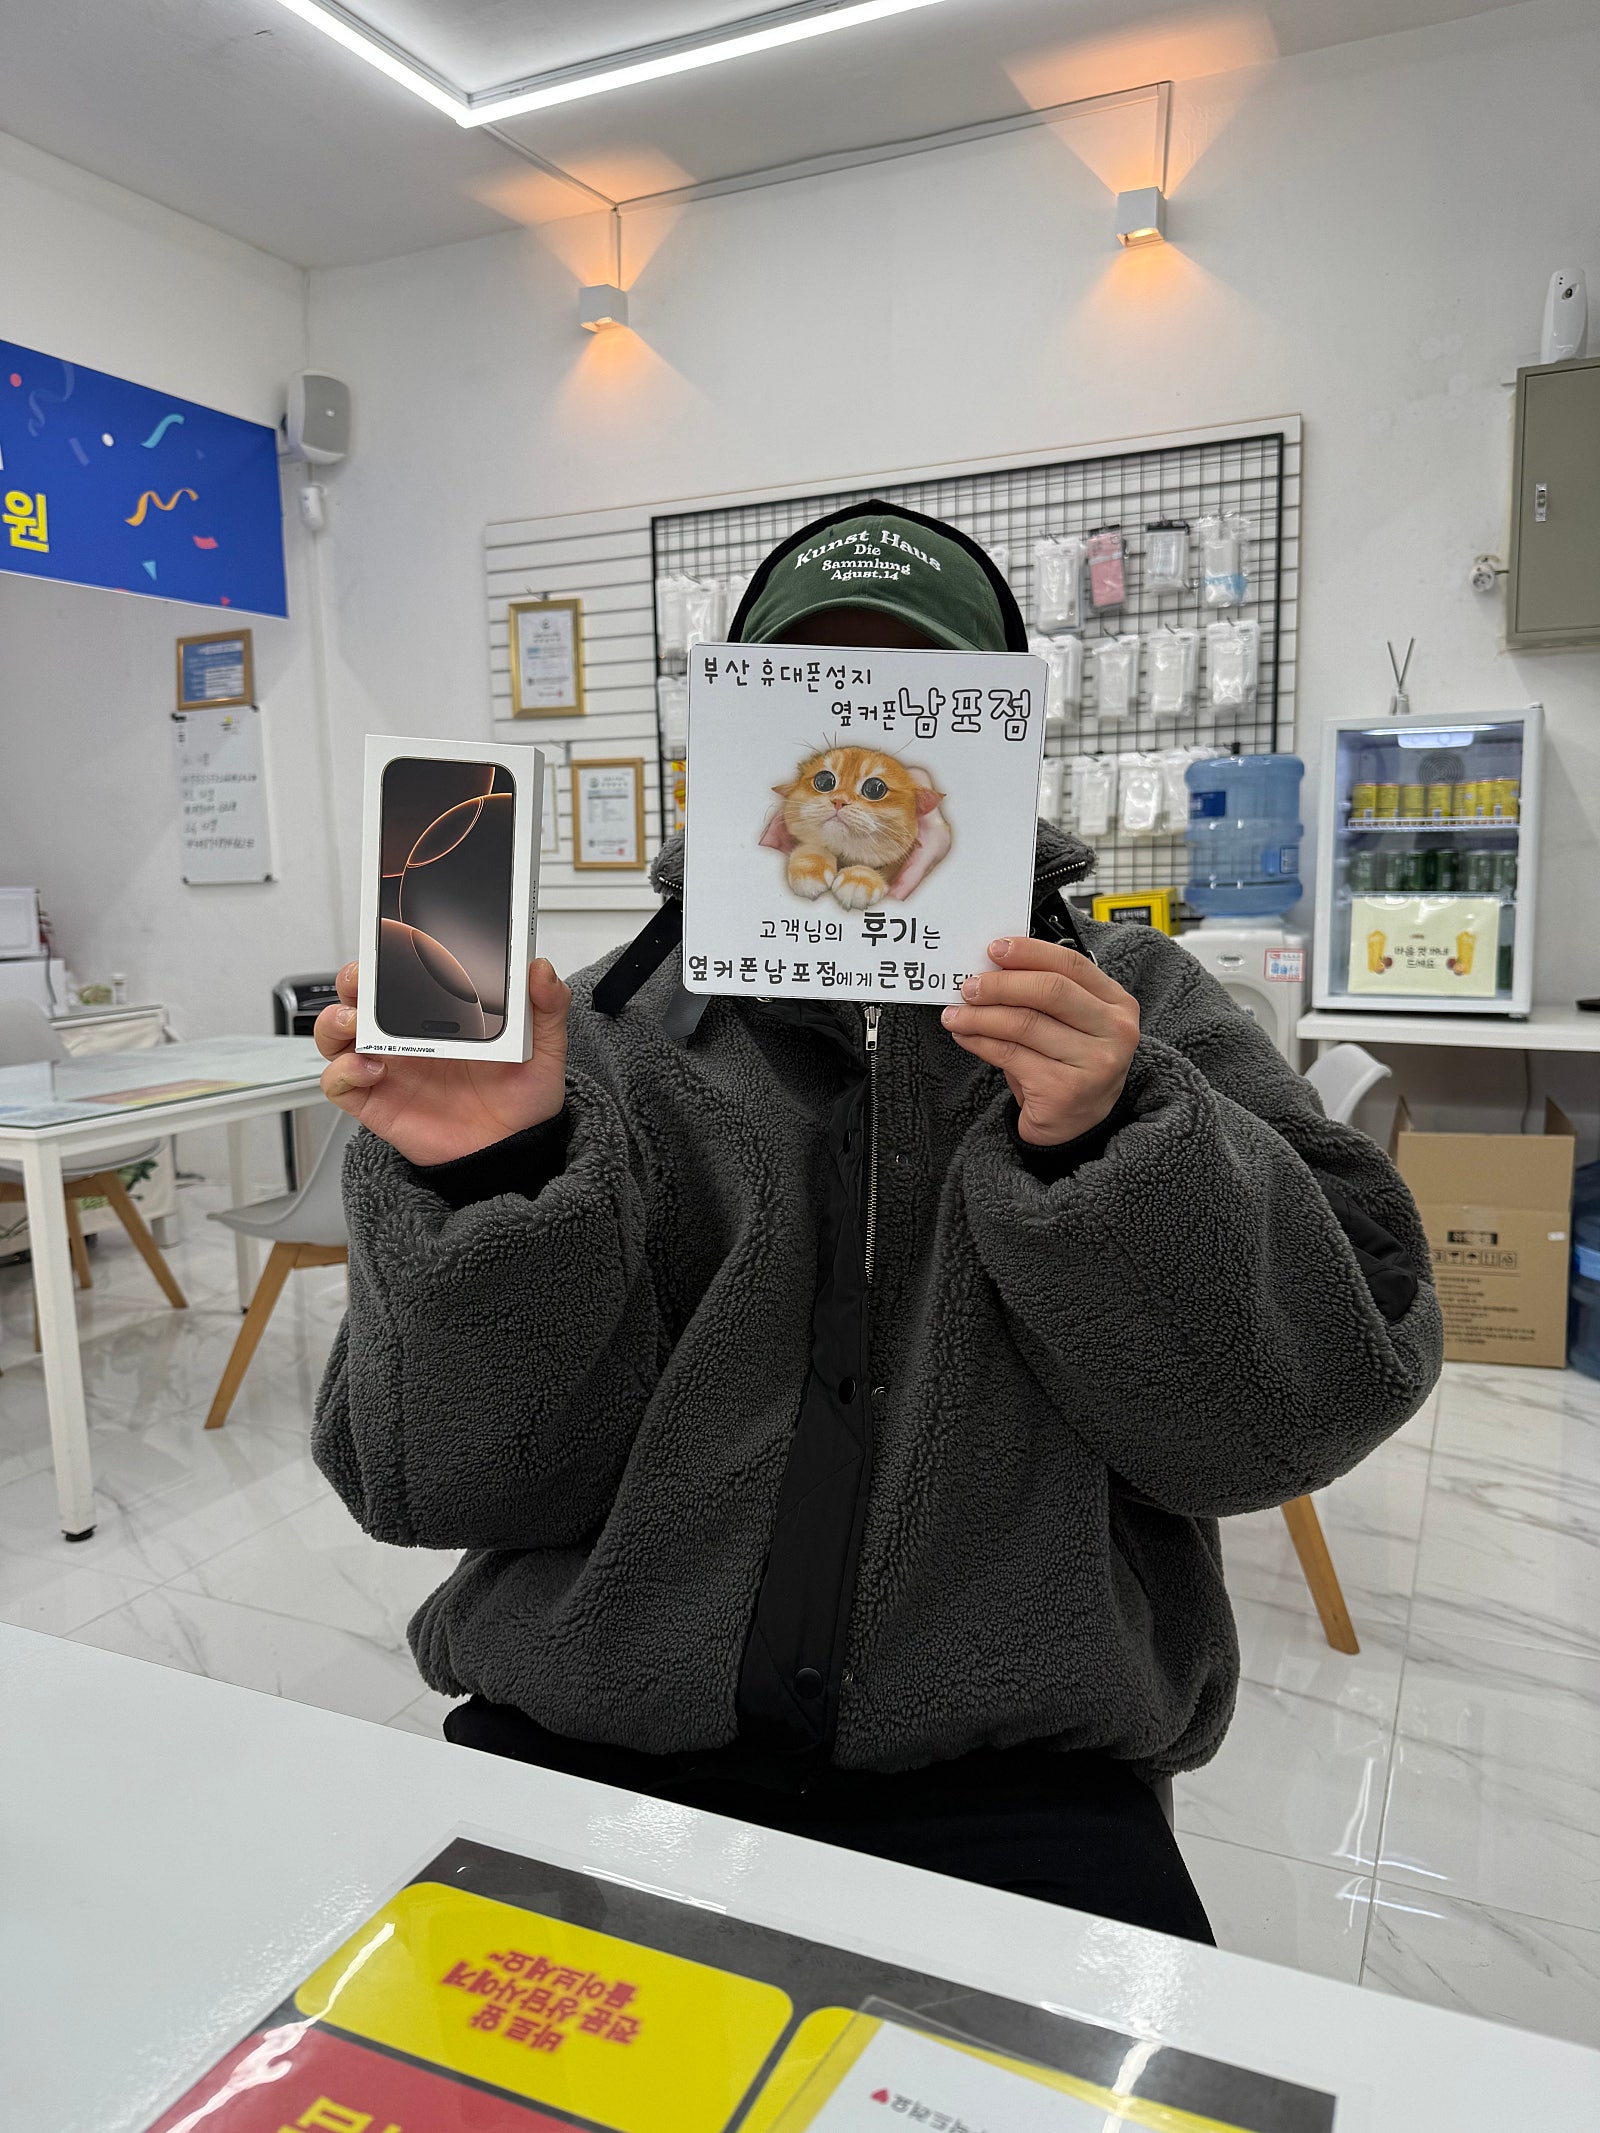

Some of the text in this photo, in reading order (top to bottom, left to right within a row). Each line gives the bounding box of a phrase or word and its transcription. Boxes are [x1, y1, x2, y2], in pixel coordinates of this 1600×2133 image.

[2, 489, 50, 553] 원
[794, 529, 942, 572] Kunst Haus
[821, 557, 911, 576] Sammlung
[853, 543, 882, 556] Die
[704, 657, 871, 693] 부산 휴대폰성지
[759, 911, 941, 950] 고객님의 후기는
[441, 1960, 640, 2045] 전문 상담사에게
[504, 2015, 565, 2053] 바로
